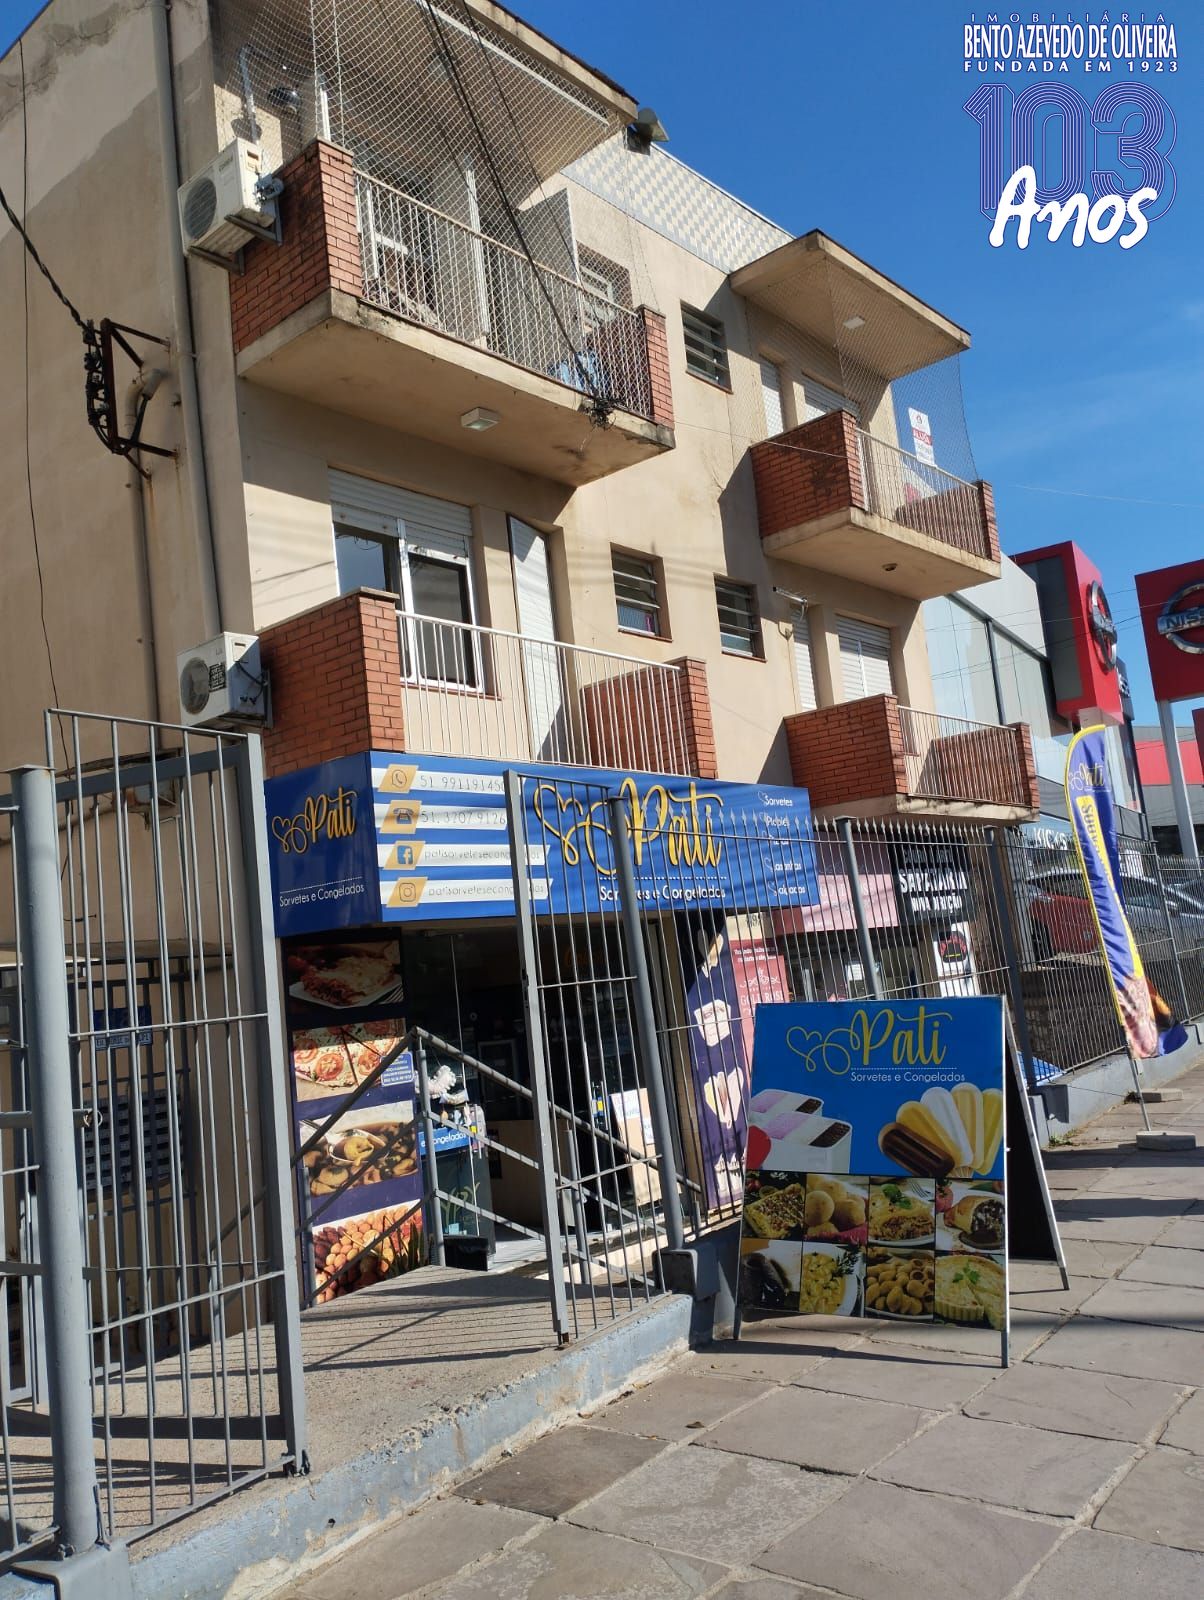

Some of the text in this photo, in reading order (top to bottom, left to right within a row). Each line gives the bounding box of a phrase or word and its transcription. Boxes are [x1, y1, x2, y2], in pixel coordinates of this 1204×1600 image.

[304, 786, 358, 843] Pati
[619, 777, 724, 868] Pati
[280, 894, 309, 906] Sorvetes
[317, 883, 365, 900] Congelados
[850, 1006, 953, 1066] Pati
[850, 1071, 965, 1083] Sorvetes e Congelados
[433, 1131, 467, 1147] ongelados
